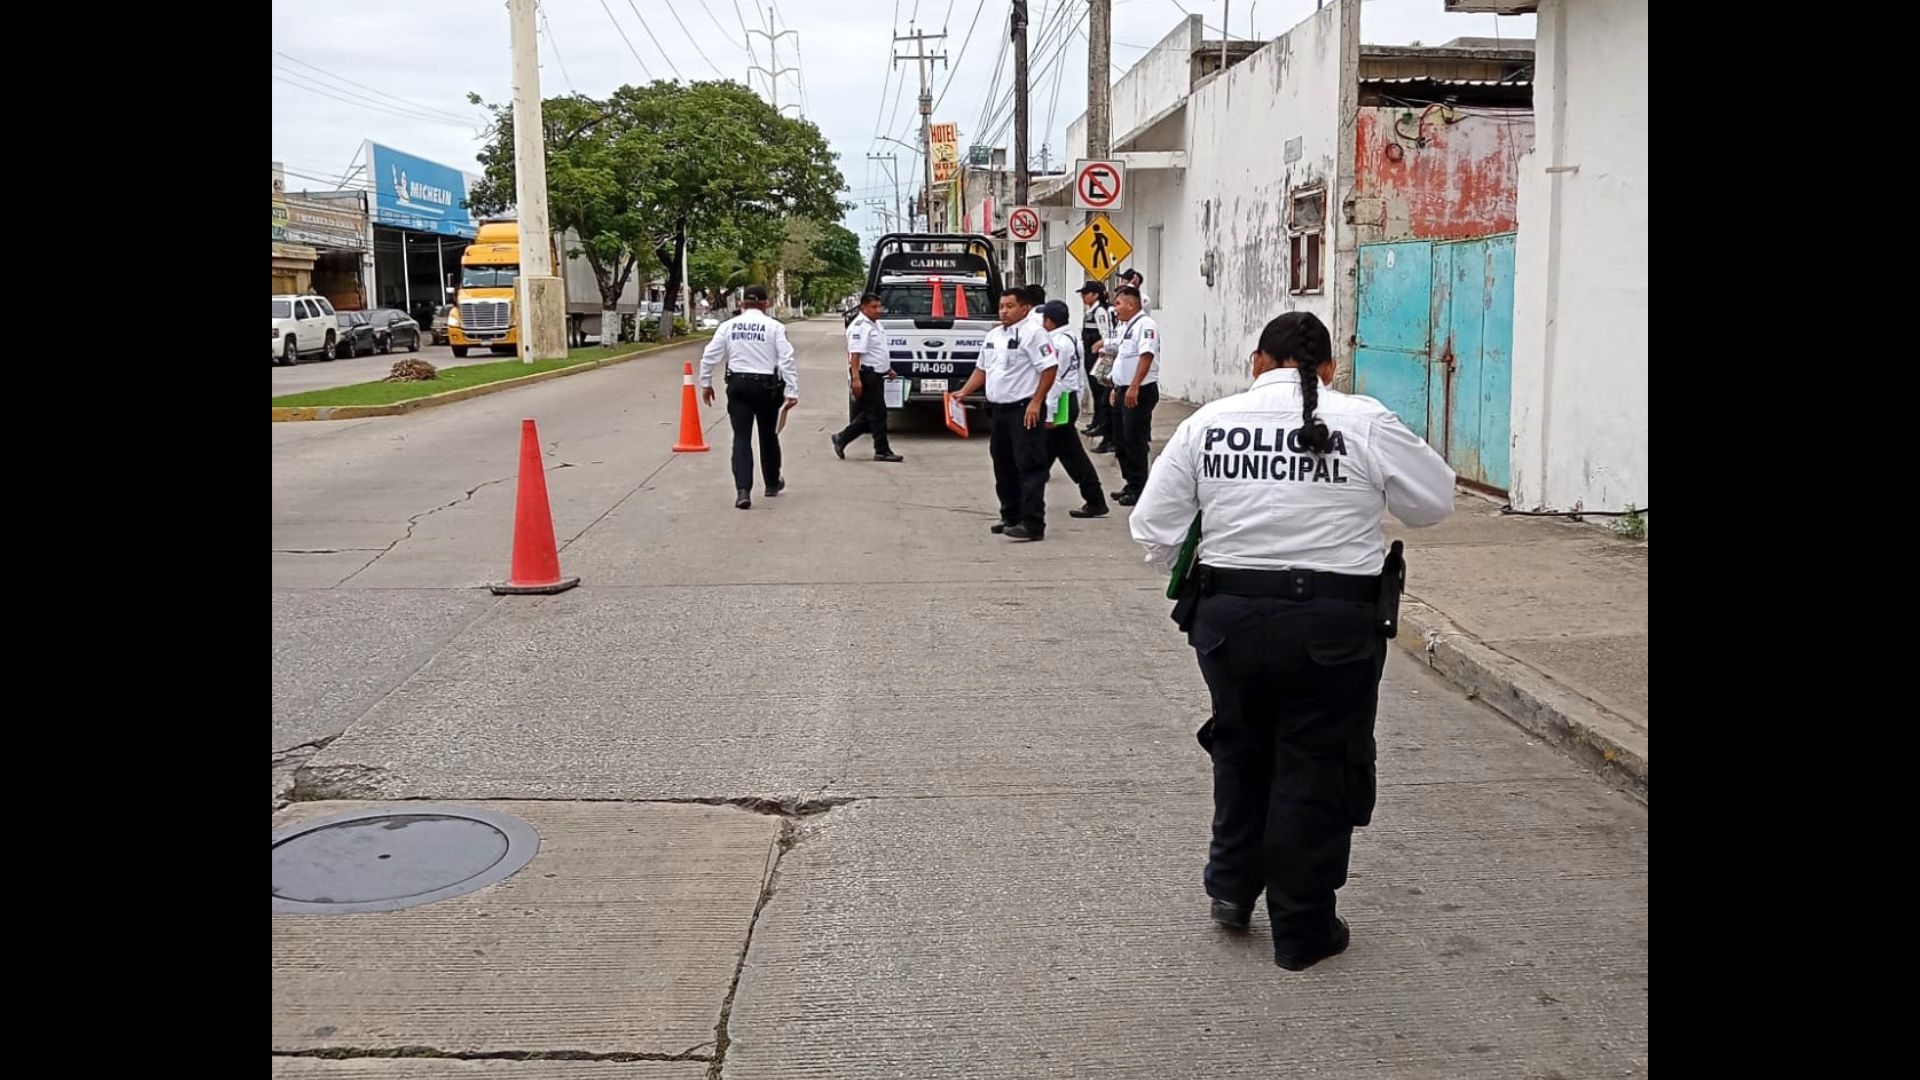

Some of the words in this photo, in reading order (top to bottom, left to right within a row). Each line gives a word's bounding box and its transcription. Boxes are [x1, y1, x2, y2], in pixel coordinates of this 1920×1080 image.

[931, 123, 957, 143] HOTEL
[410, 181, 452, 206] MICHELIN
[910, 259, 957, 268] CARMEN
[731, 331, 766, 342] MUNICIPAL
[911, 362, 954, 374] PM-090
[1204, 427, 1347, 456] POLICA
[1203, 453, 1348, 484] MUNICIPAL
